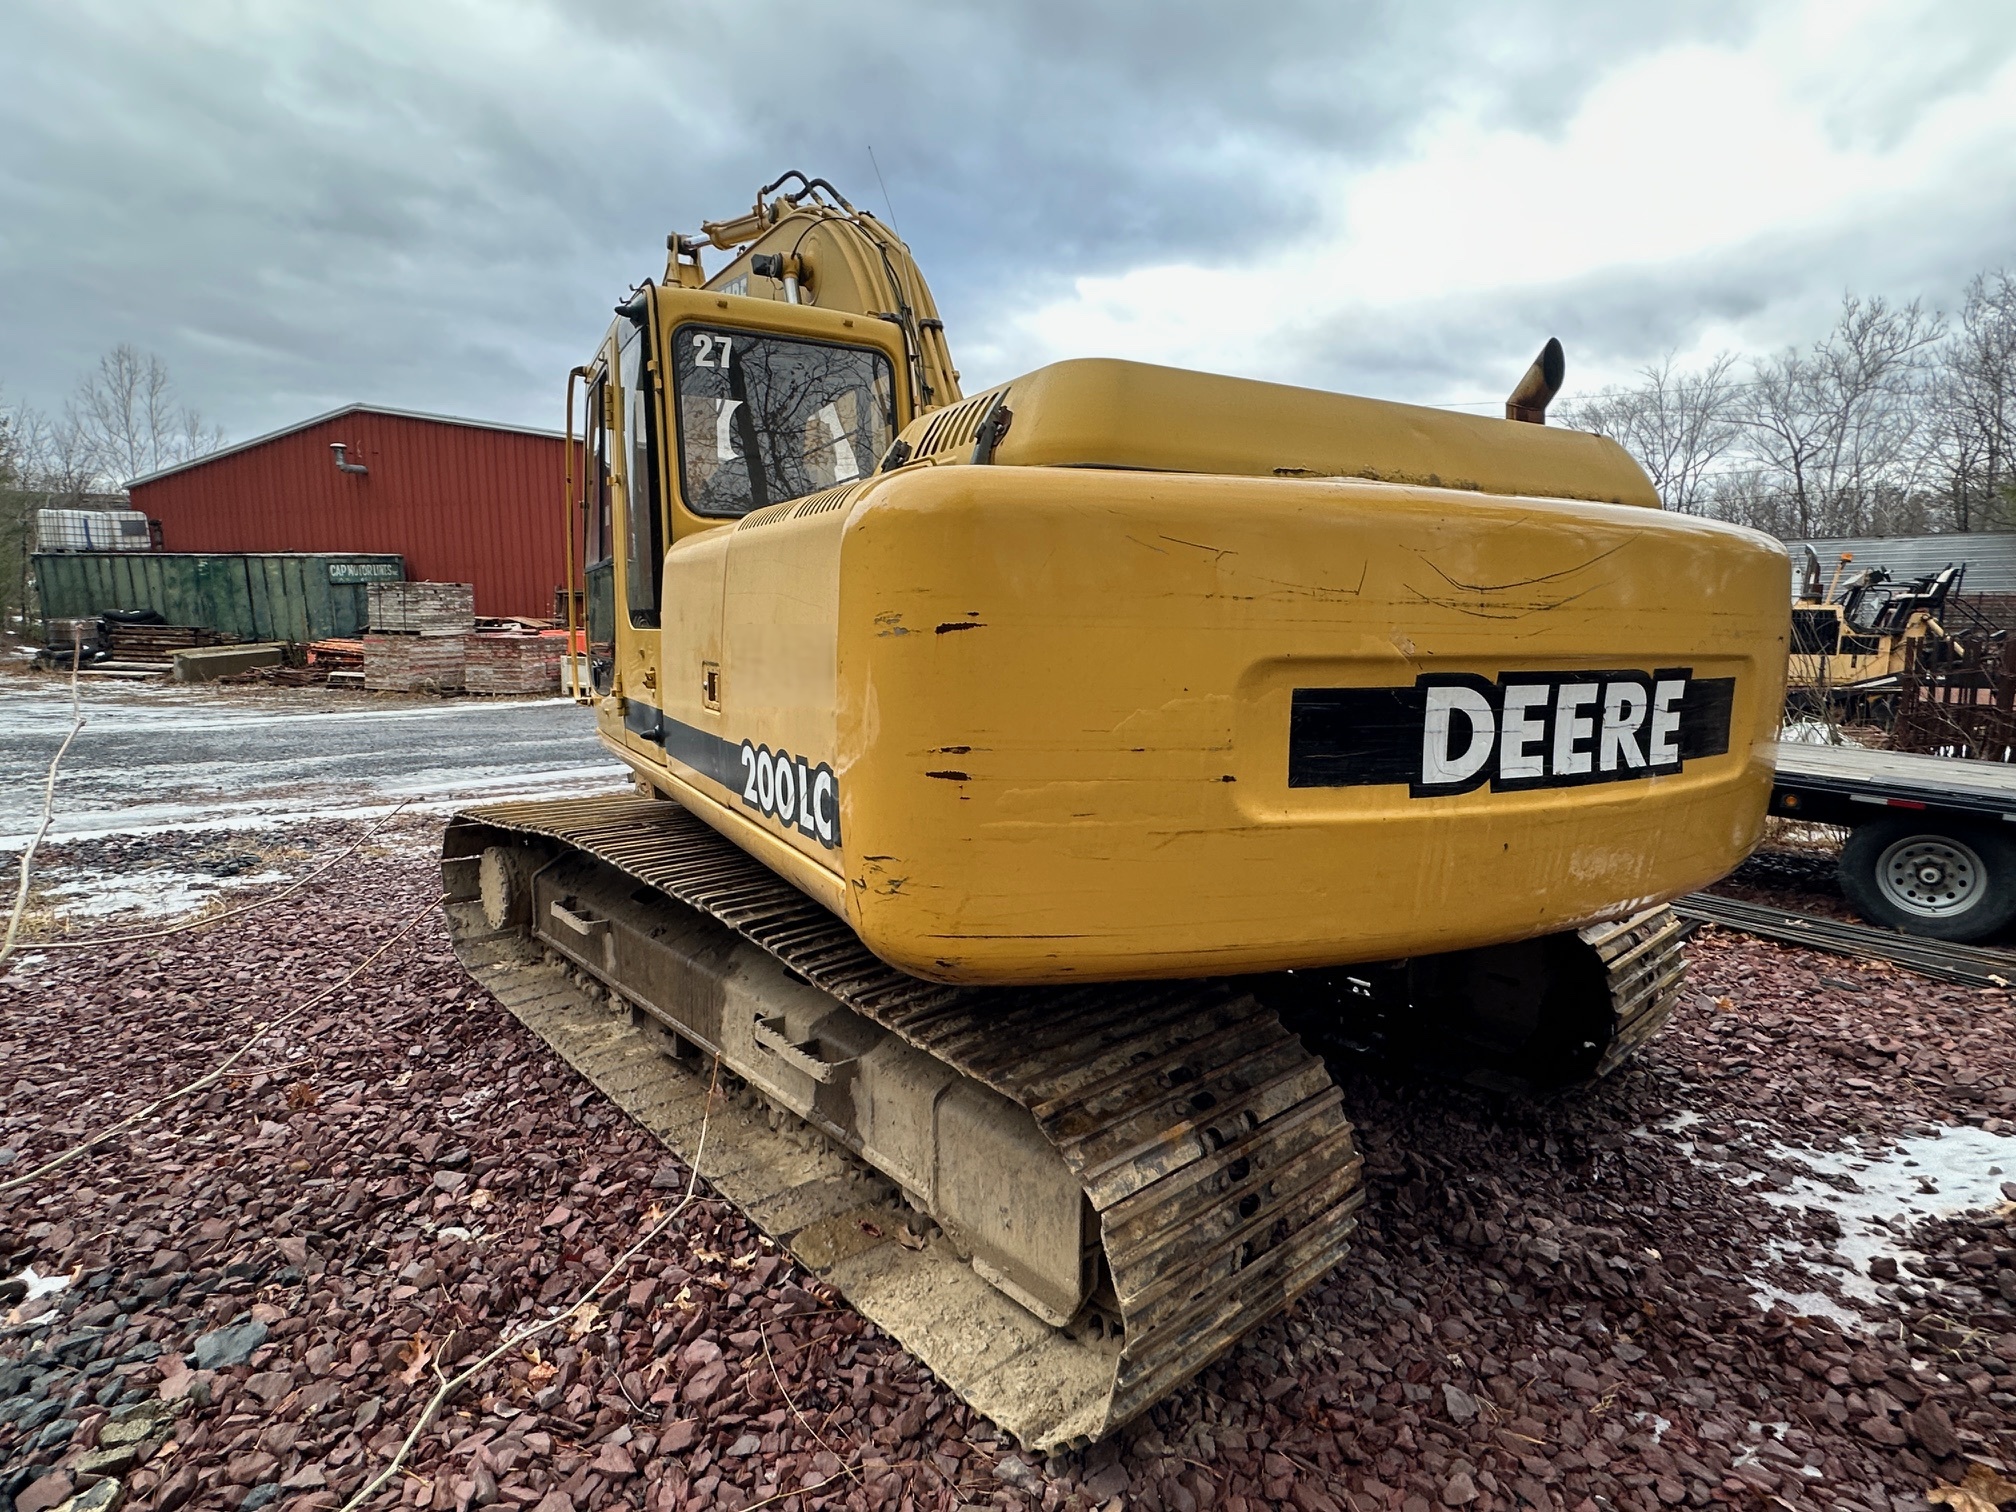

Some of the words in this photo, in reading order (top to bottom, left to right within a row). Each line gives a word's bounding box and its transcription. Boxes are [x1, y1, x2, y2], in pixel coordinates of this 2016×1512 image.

[693, 334, 732, 368] 27
[329, 564, 347, 576] CAP
[1422, 680, 1686, 784] DEERE
